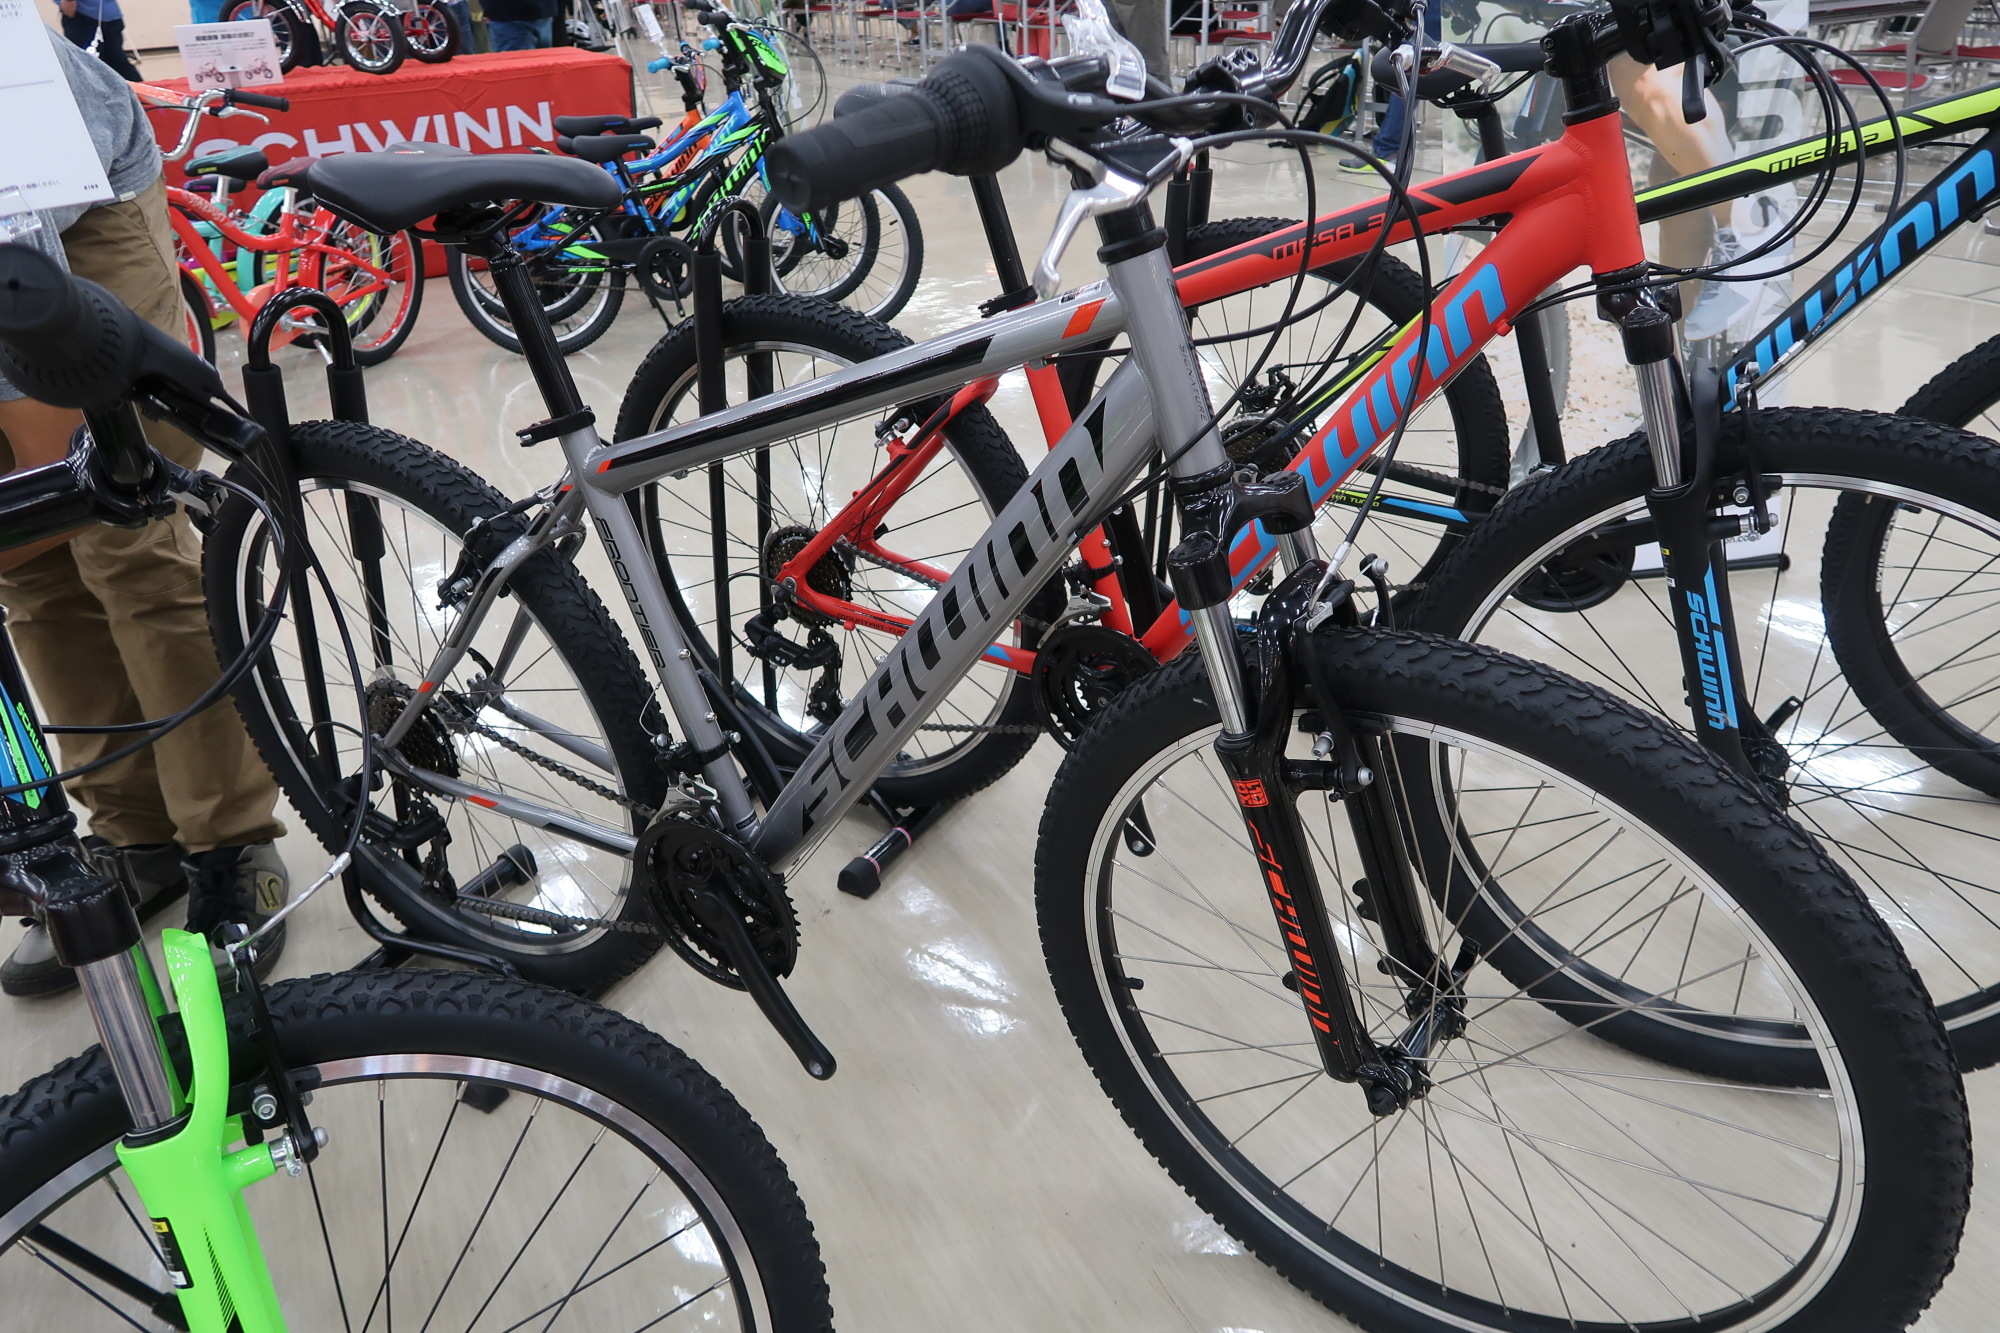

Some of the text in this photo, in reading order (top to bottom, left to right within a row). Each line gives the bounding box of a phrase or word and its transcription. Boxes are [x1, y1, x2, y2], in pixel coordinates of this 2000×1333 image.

[1179, 344, 1209, 421] SIGNATURE
[596, 516, 667, 670] FRONTIER
[801, 396, 1107, 838] SCHWINN
[837, 613, 884, 631] MOUNTAIN
[1685, 590, 1726, 731] SCHWINN
